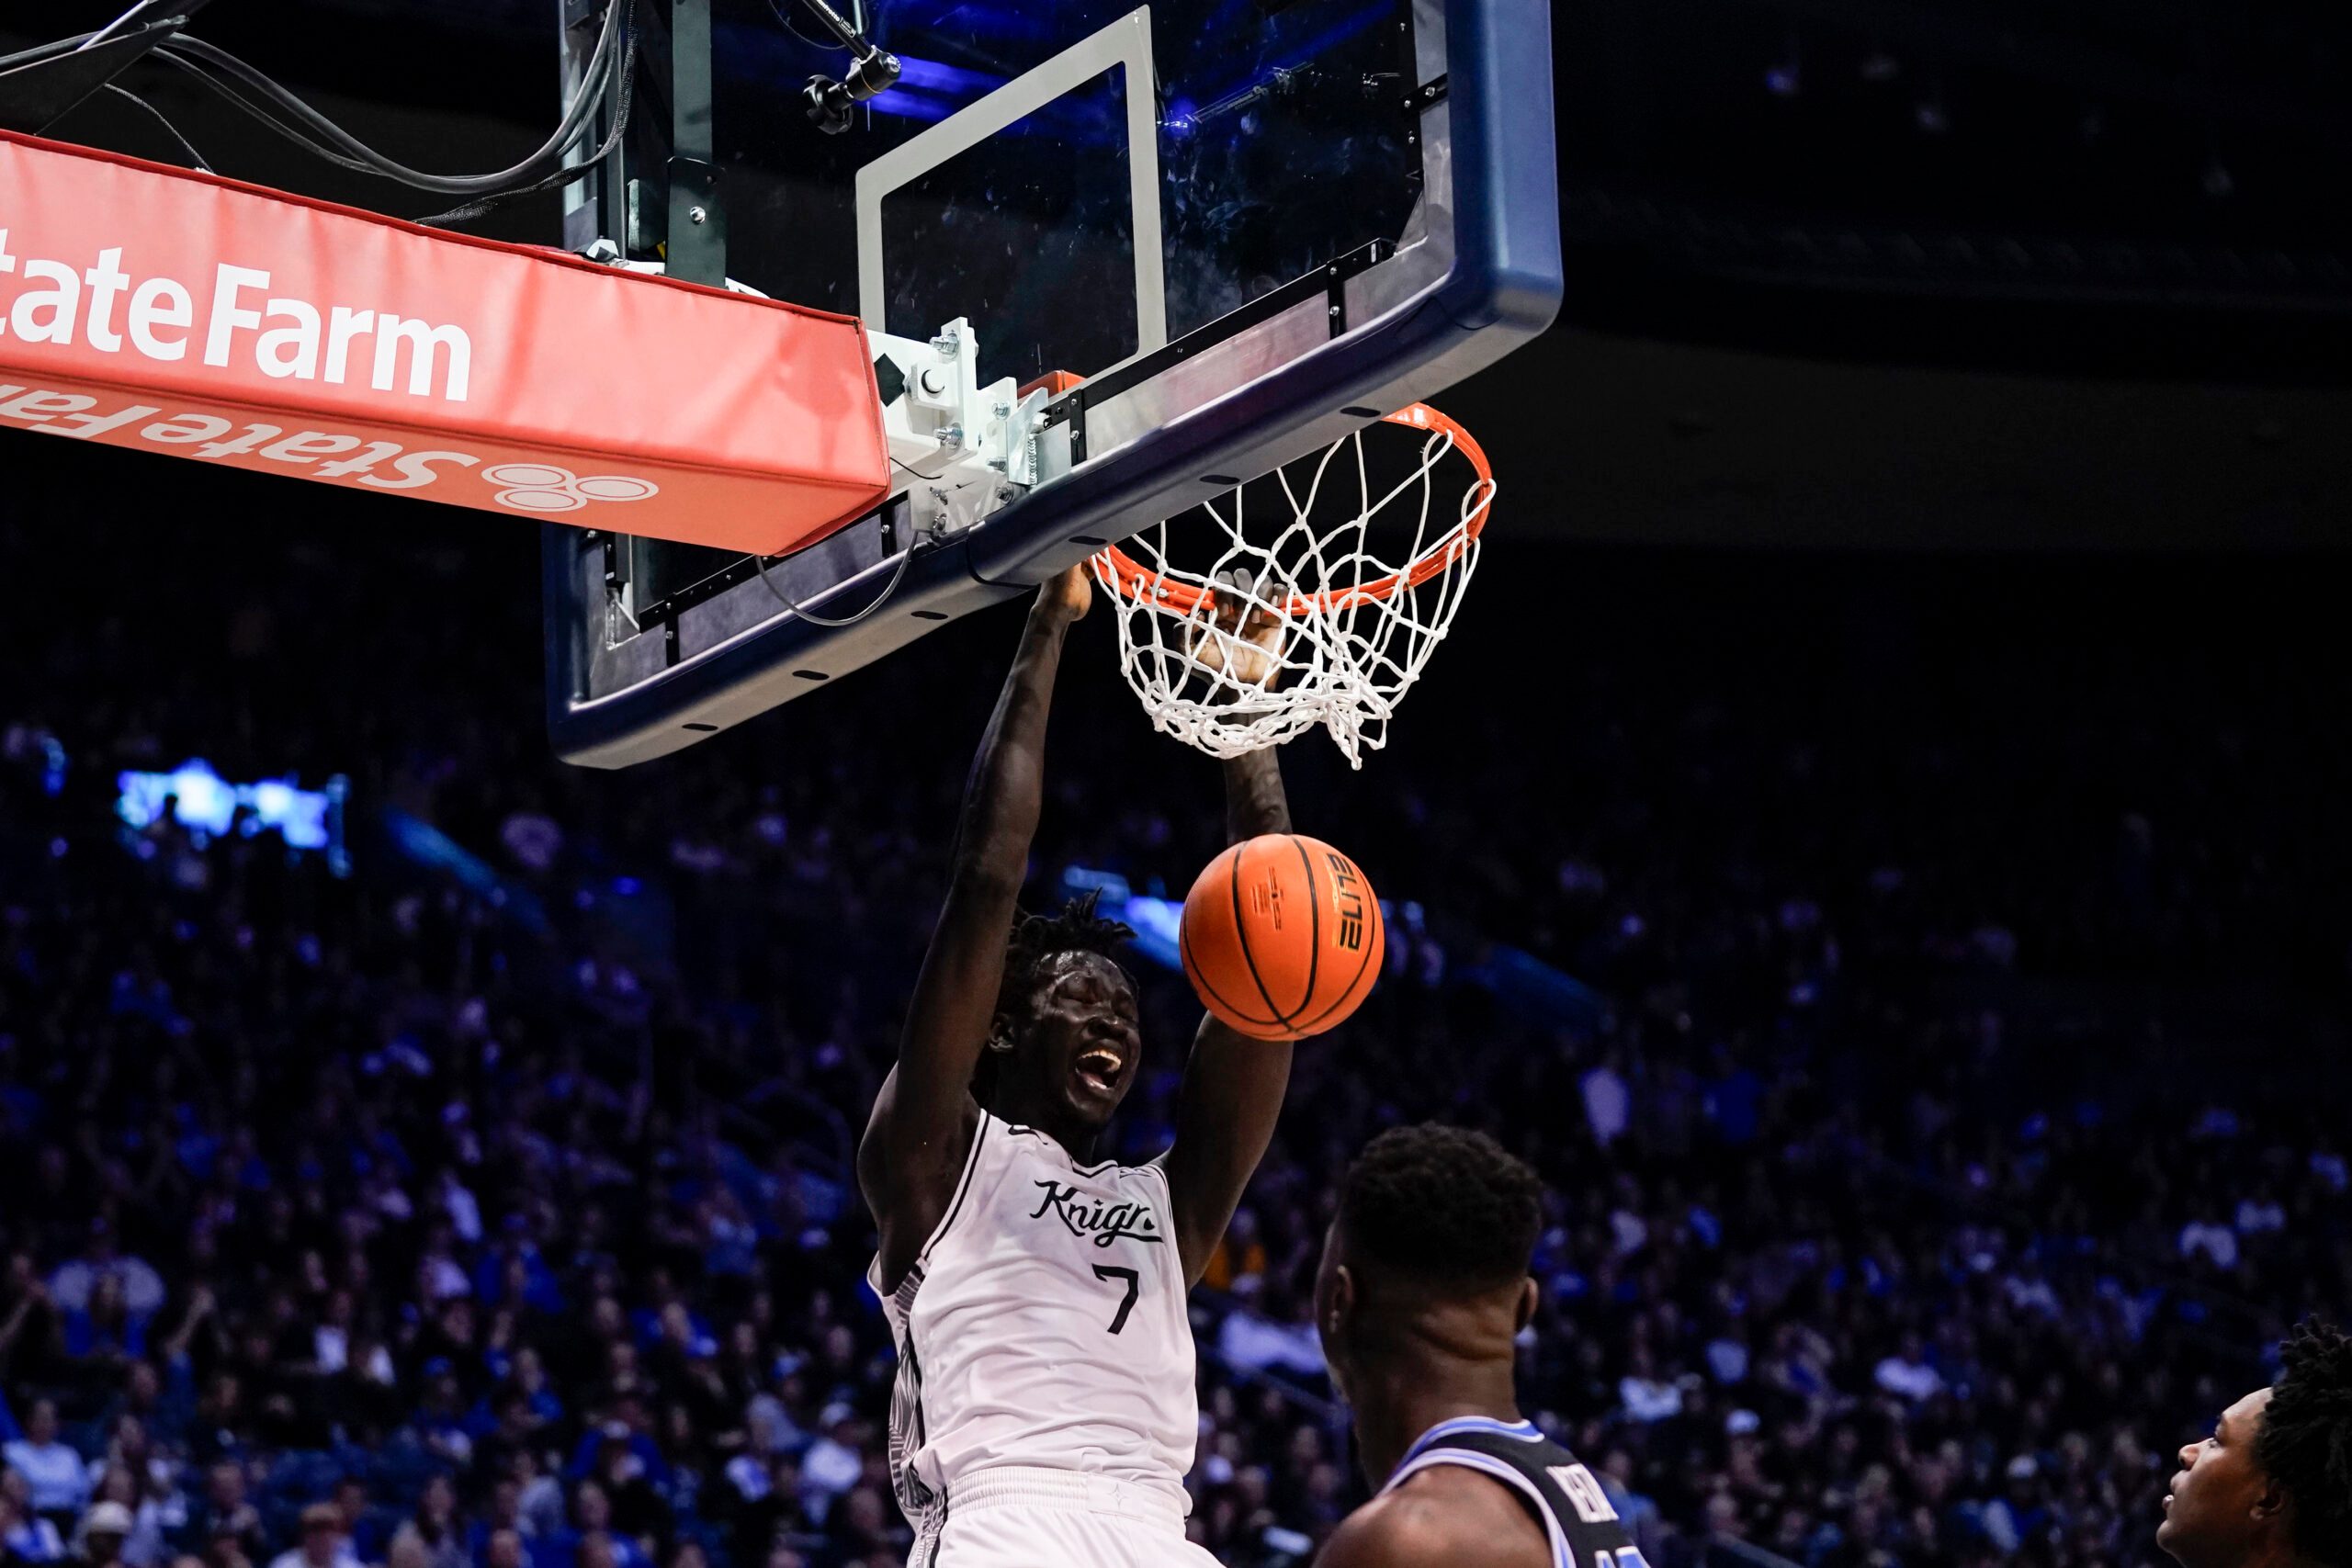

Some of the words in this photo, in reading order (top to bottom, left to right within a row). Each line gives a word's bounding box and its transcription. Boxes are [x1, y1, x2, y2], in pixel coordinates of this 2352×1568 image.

[204, 263, 471, 402] Farm
[140, 412, 481, 490] State
[1327, 852, 1363, 952] ELITE
[1091, 1263, 1139, 1336] 7
